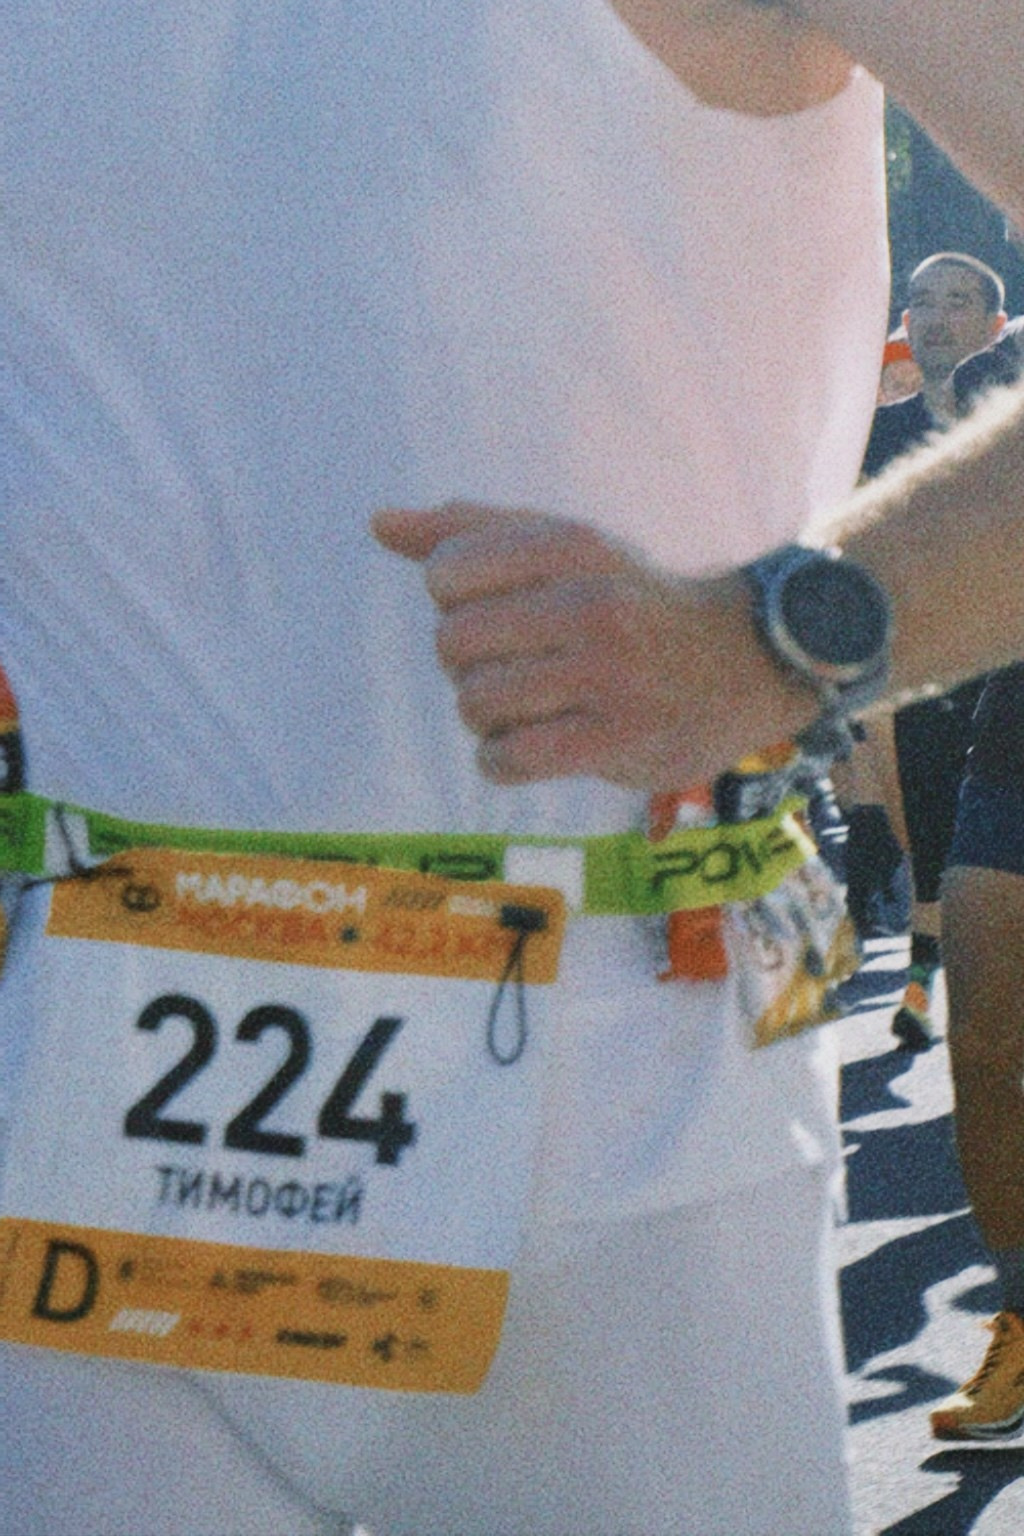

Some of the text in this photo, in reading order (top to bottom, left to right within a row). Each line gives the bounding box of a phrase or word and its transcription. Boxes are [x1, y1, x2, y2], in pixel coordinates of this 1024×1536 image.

[123, 994, 417, 1165] 224
[156, 1167, 366, 1223] ТИМОФЕЙ
[32, 1238, 100, 1323] D
